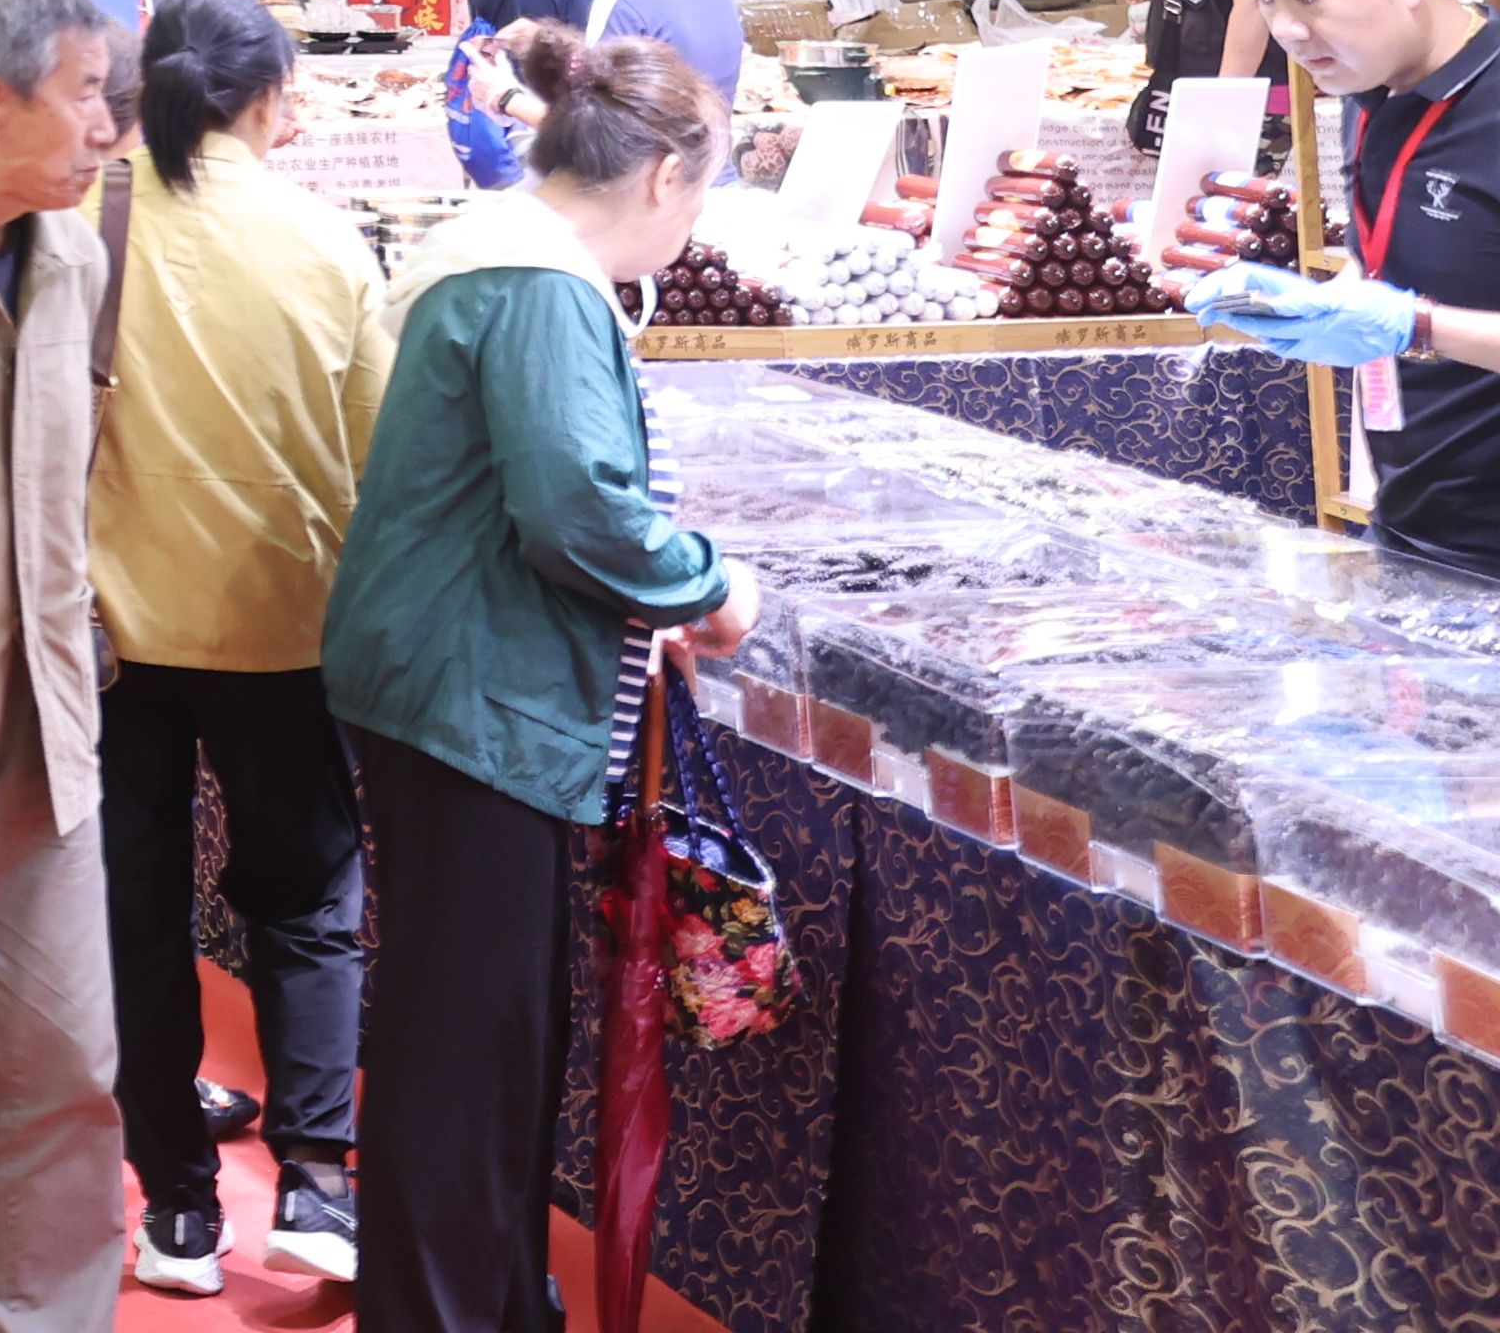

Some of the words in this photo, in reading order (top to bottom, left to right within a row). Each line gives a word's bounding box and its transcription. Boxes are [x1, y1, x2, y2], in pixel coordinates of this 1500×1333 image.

[845, 331, 938, 351] 俄罗斯商品
[1055, 324, 1148, 345] 俄罗斯商品
